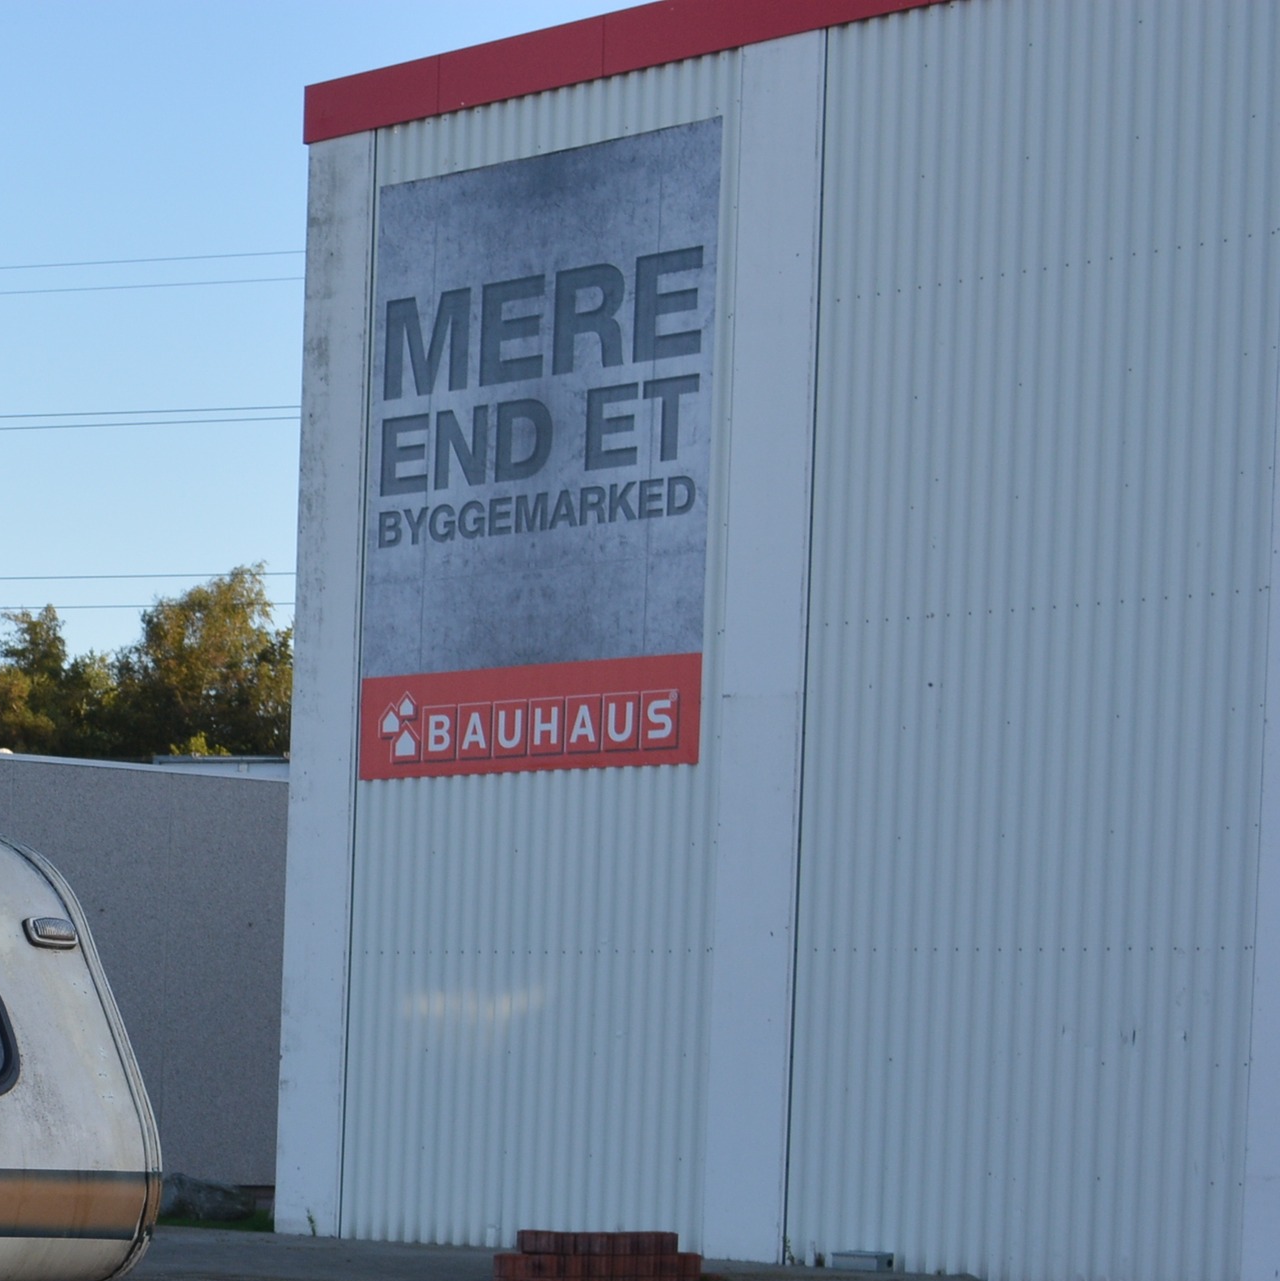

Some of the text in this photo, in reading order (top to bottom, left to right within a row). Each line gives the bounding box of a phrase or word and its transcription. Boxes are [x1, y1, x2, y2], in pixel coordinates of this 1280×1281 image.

[383, 244, 704, 401] MERE
[380, 373, 701, 497] END ET
[377, 474, 697, 550] BYGGEMARKED
[427, 699, 673, 752] BAUHAUS
